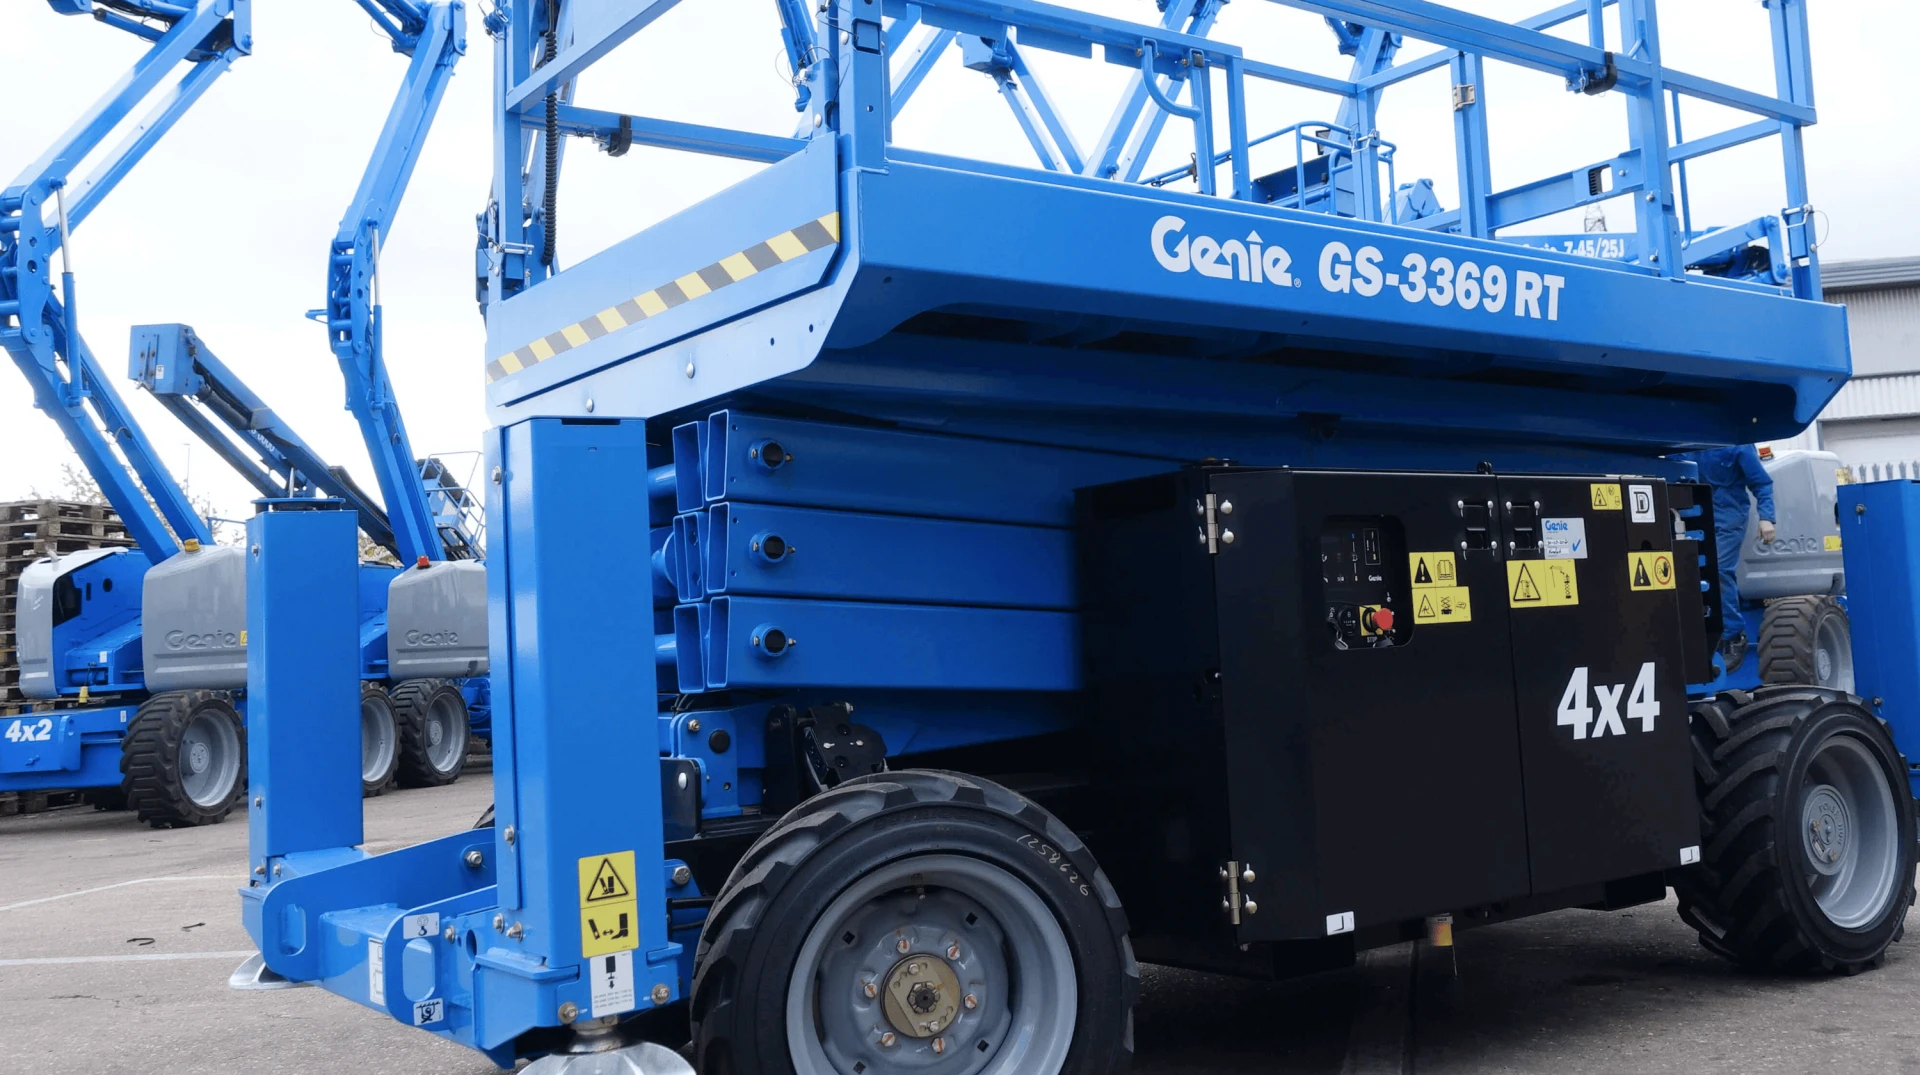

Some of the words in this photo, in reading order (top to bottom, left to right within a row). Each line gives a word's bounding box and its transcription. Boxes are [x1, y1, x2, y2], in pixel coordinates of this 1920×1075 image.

[1151, 215, 1293, 287] Genie
[1318, 241, 1507, 313] GS-3369
[1514, 270, 1565, 321] RT
[1545, 520, 1568, 531] Genie
[164, 629, 237, 651] Genie
[405, 629, 458, 647] Genie
[1557, 661, 1660, 740] 4x4
[4, 718, 53, 742] 4x2
